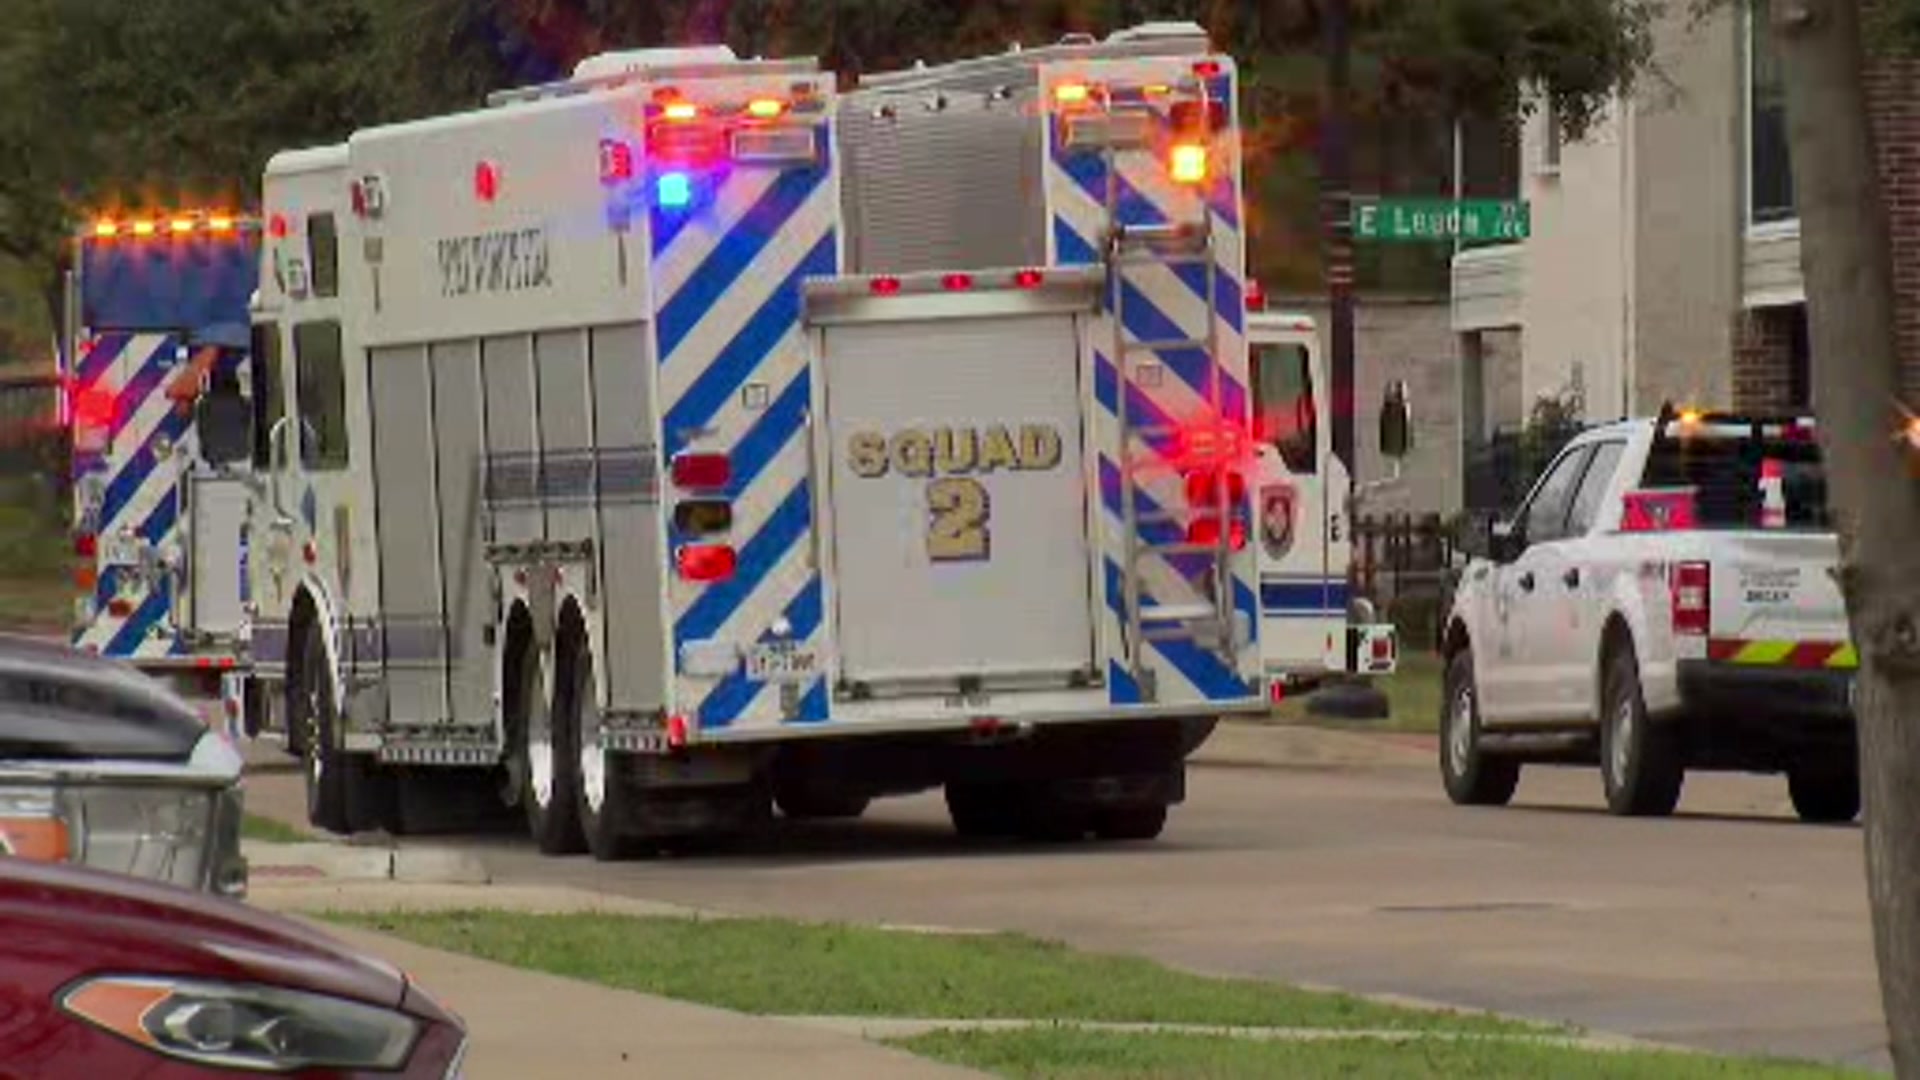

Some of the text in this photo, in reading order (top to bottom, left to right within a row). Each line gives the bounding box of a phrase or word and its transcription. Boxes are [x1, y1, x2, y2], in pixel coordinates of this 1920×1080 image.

[1360, 205, 1377, 235] E
[848, 424, 1063, 478] SQUAD
[925, 477, 990, 563] 2
